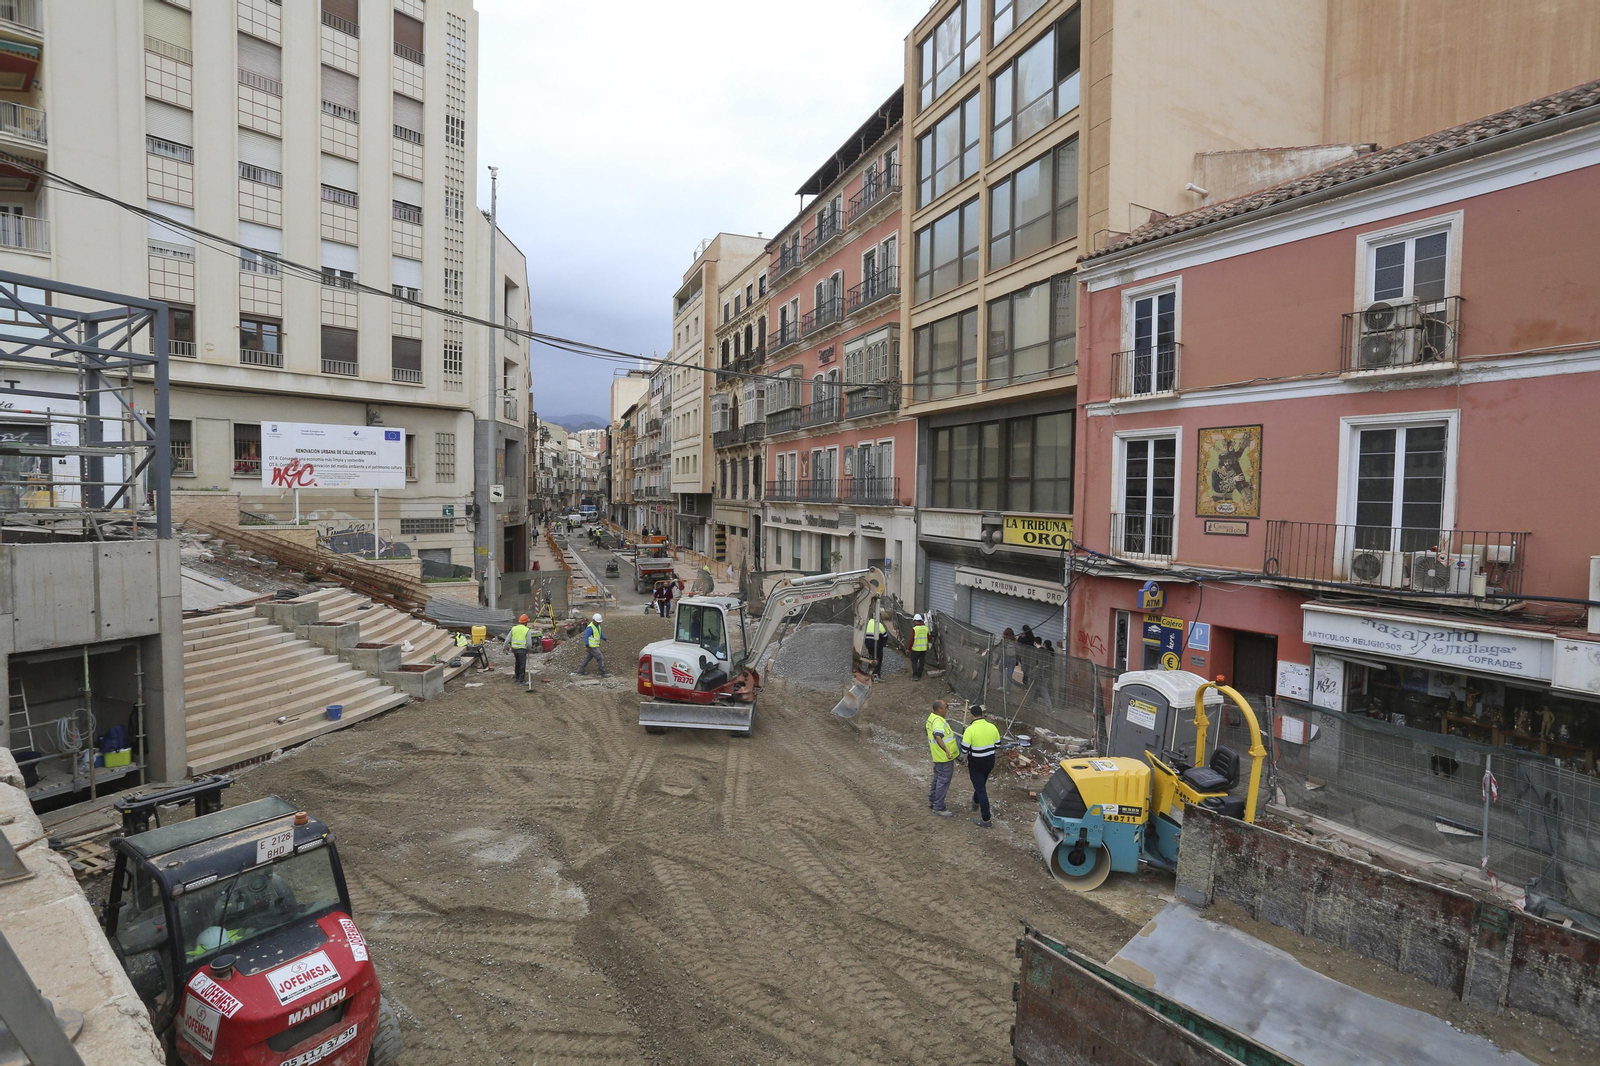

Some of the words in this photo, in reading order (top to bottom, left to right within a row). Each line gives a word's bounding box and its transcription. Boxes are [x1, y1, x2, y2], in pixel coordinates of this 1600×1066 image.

[1006, 518, 1018, 529] LA
[1021, 519, 1068, 533] TRIBUNA
[1023, 531, 1066, 547] ORO
[801, 592, 831, 600] TAKEUCHI
[975, 577, 982, 585] LA
[991, 580, 1018, 593] TRIBUNA
[1027, 588, 1036, 596] DE
[1046, 592, 1062, 601] ORO
[1146, 599, 1160, 608] ATM
[1162, 618, 1183, 628] Cajero
[1195, 627, 1203, 640] P
[1306, 630, 1350, 643] ARTICULOS
[1352, 637, 1402, 651] RELIGIOSOS
[1431, 643, 1444, 654] de
[1467, 655, 1523, 670] COFRADES
[673, 675, 695, 685] TB370
[260, 840, 266, 850] E
[267, 845, 285, 859] BHD
[278, 963, 331, 994] JOFEMESA
[200, 982, 240, 1016] JOFEMESA
[288, 986, 347, 1026] MANITOU
[185, 1013, 214, 1044] JOFEMESA
[302, 1047, 323, 1062] 117
[342, 1026, 355, 1040] 30
